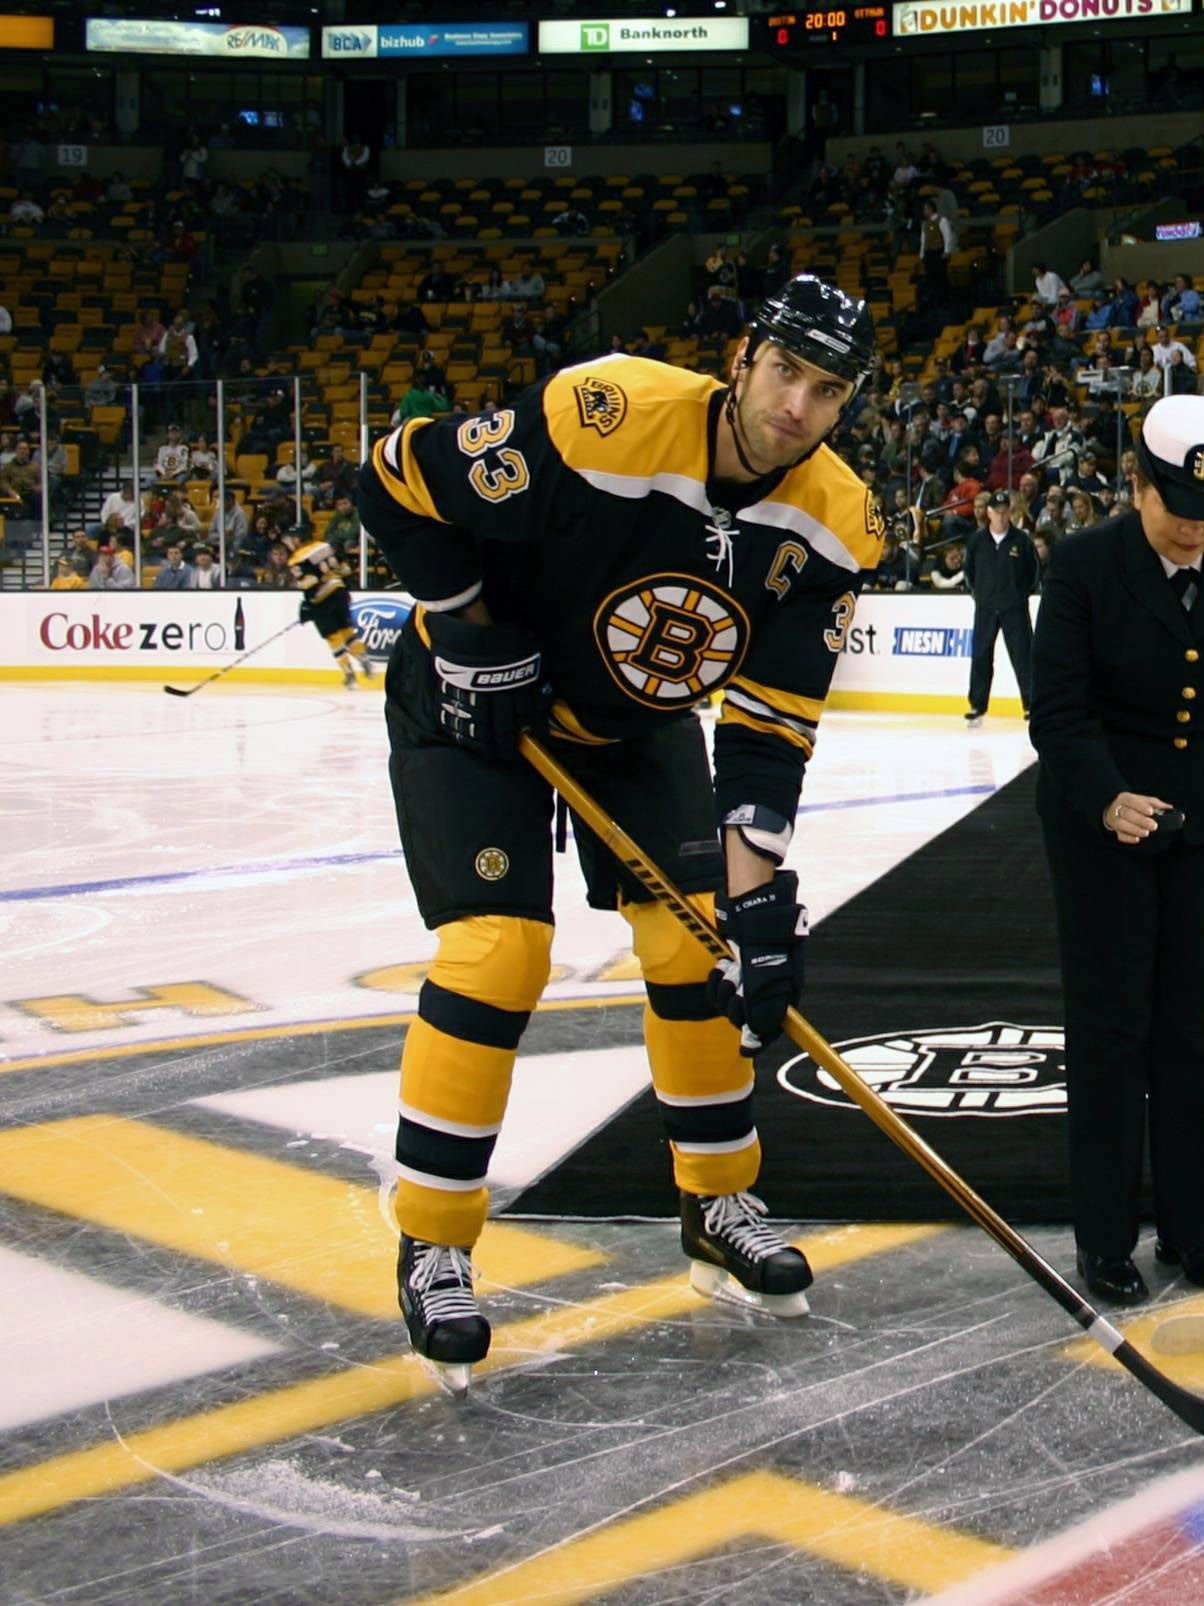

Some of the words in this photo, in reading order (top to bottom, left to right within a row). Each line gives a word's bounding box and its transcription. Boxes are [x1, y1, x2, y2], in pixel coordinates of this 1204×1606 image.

[805, 11, 845, 29] 20:00
[919, 2, 1036, 31] DUNKIN'
[1038, 0, 1154, 21] DONUTS
[333, 36, 362, 51] BCA
[380, 36, 425, 48] bizhub
[583, 27, 608, 46] TD
[620, 26, 708, 40] Banknorth
[777, 28, 788, 45] 0
[987, 128, 1005, 144] 20
[63, 147, 82, 164] 19
[548, 149, 568, 164] 20
[457, 408, 530, 504] 33
[765, 540, 808, 600] C
[40, 612, 134, 651] Coke
[139, 622, 226, 651] zero
[357, 608, 402, 650] For
[901, 630, 945, 654] NESN
